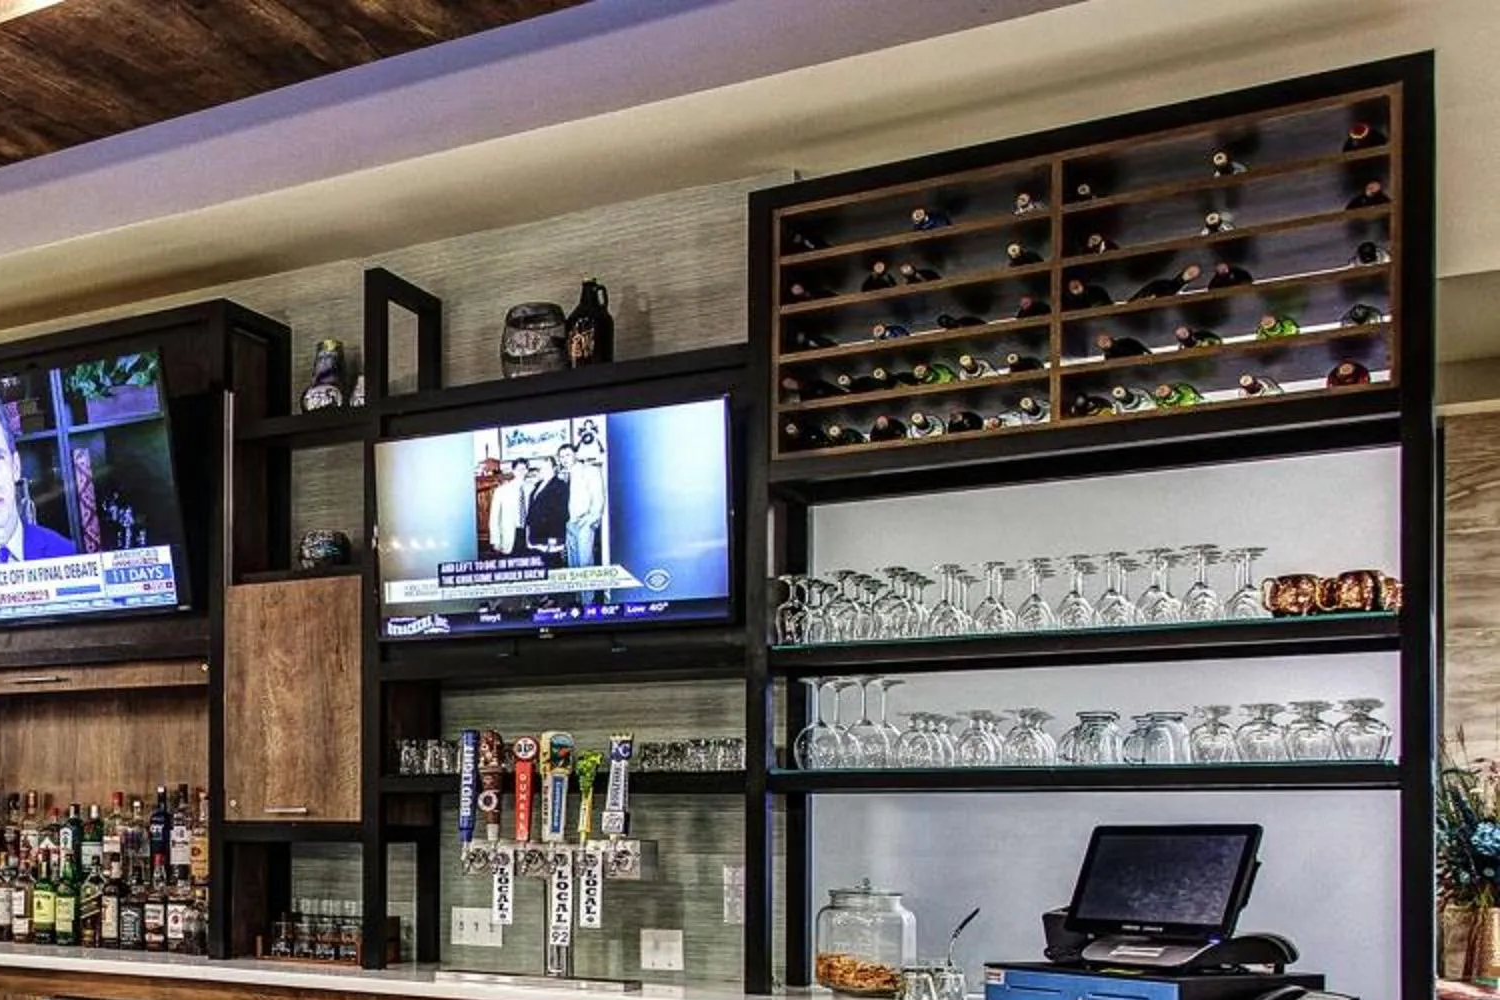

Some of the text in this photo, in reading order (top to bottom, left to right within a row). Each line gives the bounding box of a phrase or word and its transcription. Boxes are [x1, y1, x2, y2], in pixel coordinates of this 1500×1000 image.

[10, 569, 25, 585] OFF
[38, 565, 63, 582] FINAL
[64, 561, 99, 579] DEBATE
[112, 566, 164, 583] 11 DAYS
[461, 744, 475, 817] BUD LIGHT
[497, 867, 509, 912] LOCAL
[555, 870, 569, 923] LOCAL
[584, 869, 597, 915] LOCAL
[551, 931, 569, 943] 92
